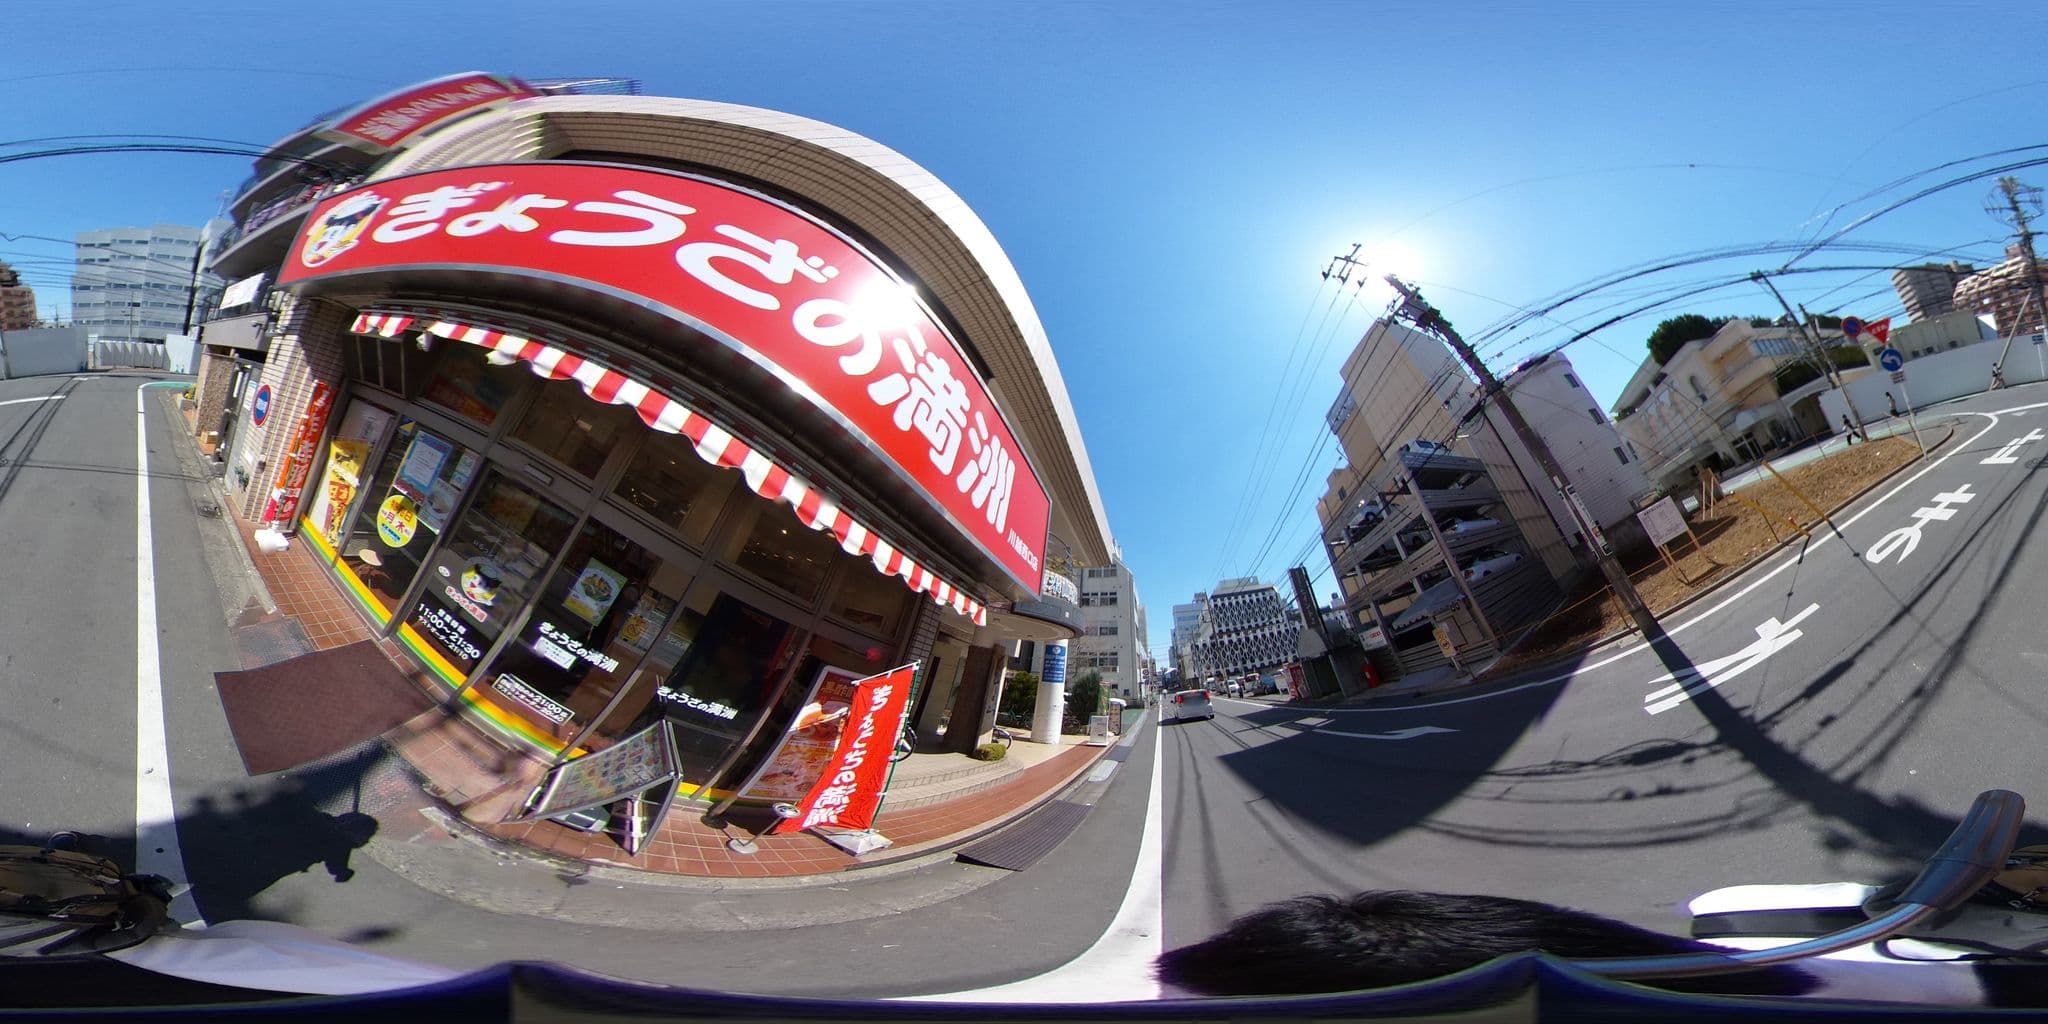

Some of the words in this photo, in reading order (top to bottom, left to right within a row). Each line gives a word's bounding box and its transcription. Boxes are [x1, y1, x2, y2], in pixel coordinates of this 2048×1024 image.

[371, 181, 1016, 534] ぎょうざの満洲
[1007, 527, 1039, 572] 川越西口店
[1644, 428, 2046, 716] 止まれ
[539, 621, 619, 673] ぎょうざの満洲
[657, 685, 739, 720] ぎょうざの満洲
